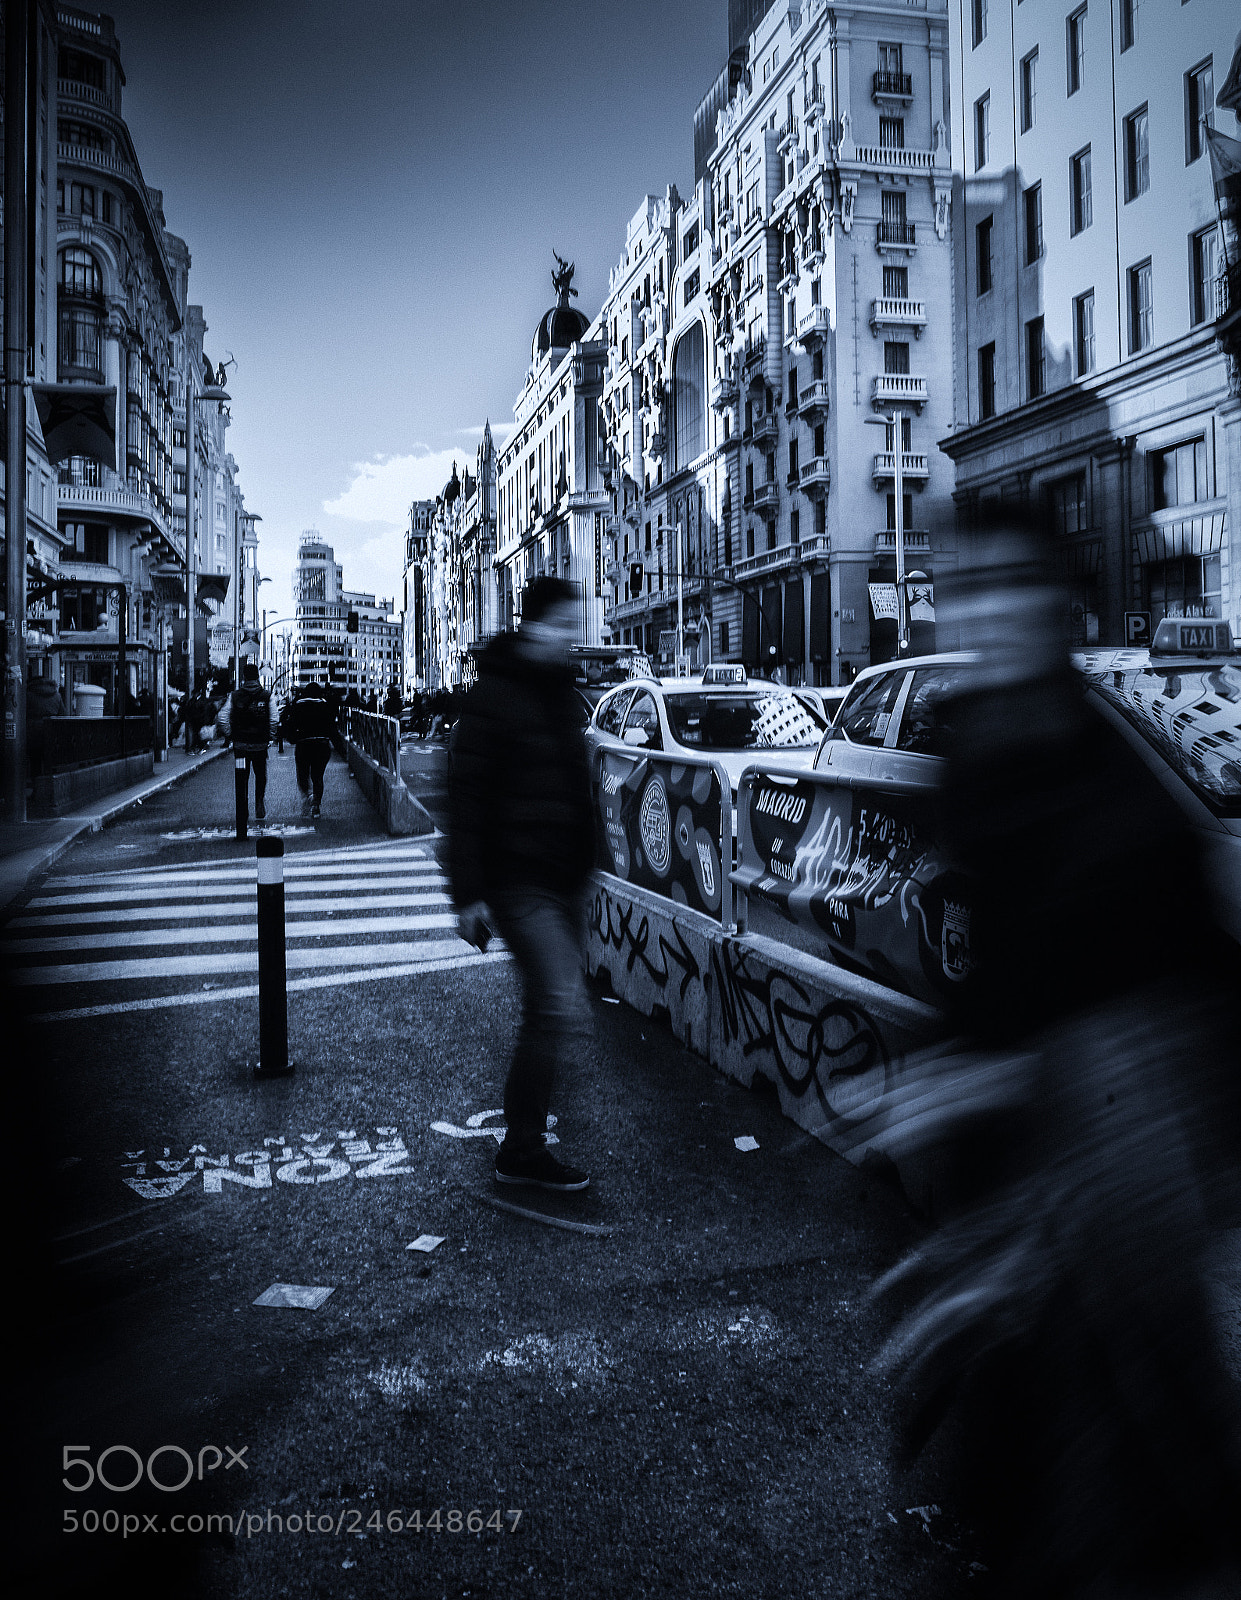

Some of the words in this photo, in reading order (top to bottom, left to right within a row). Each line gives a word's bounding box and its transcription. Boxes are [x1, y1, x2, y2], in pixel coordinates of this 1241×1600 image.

[1128, 616, 1146, 640] P
[1181, 628, 1213, 646] TAXI
[716, 669, 734, 682] TAXI
[756, 788, 807, 824] MADRID
[771, 837, 784, 854] UN
[829, 897, 849, 920] PARA
[120, 1137, 406, 1175] PEATONAL
[121, 1150, 415, 1200] ZONA
